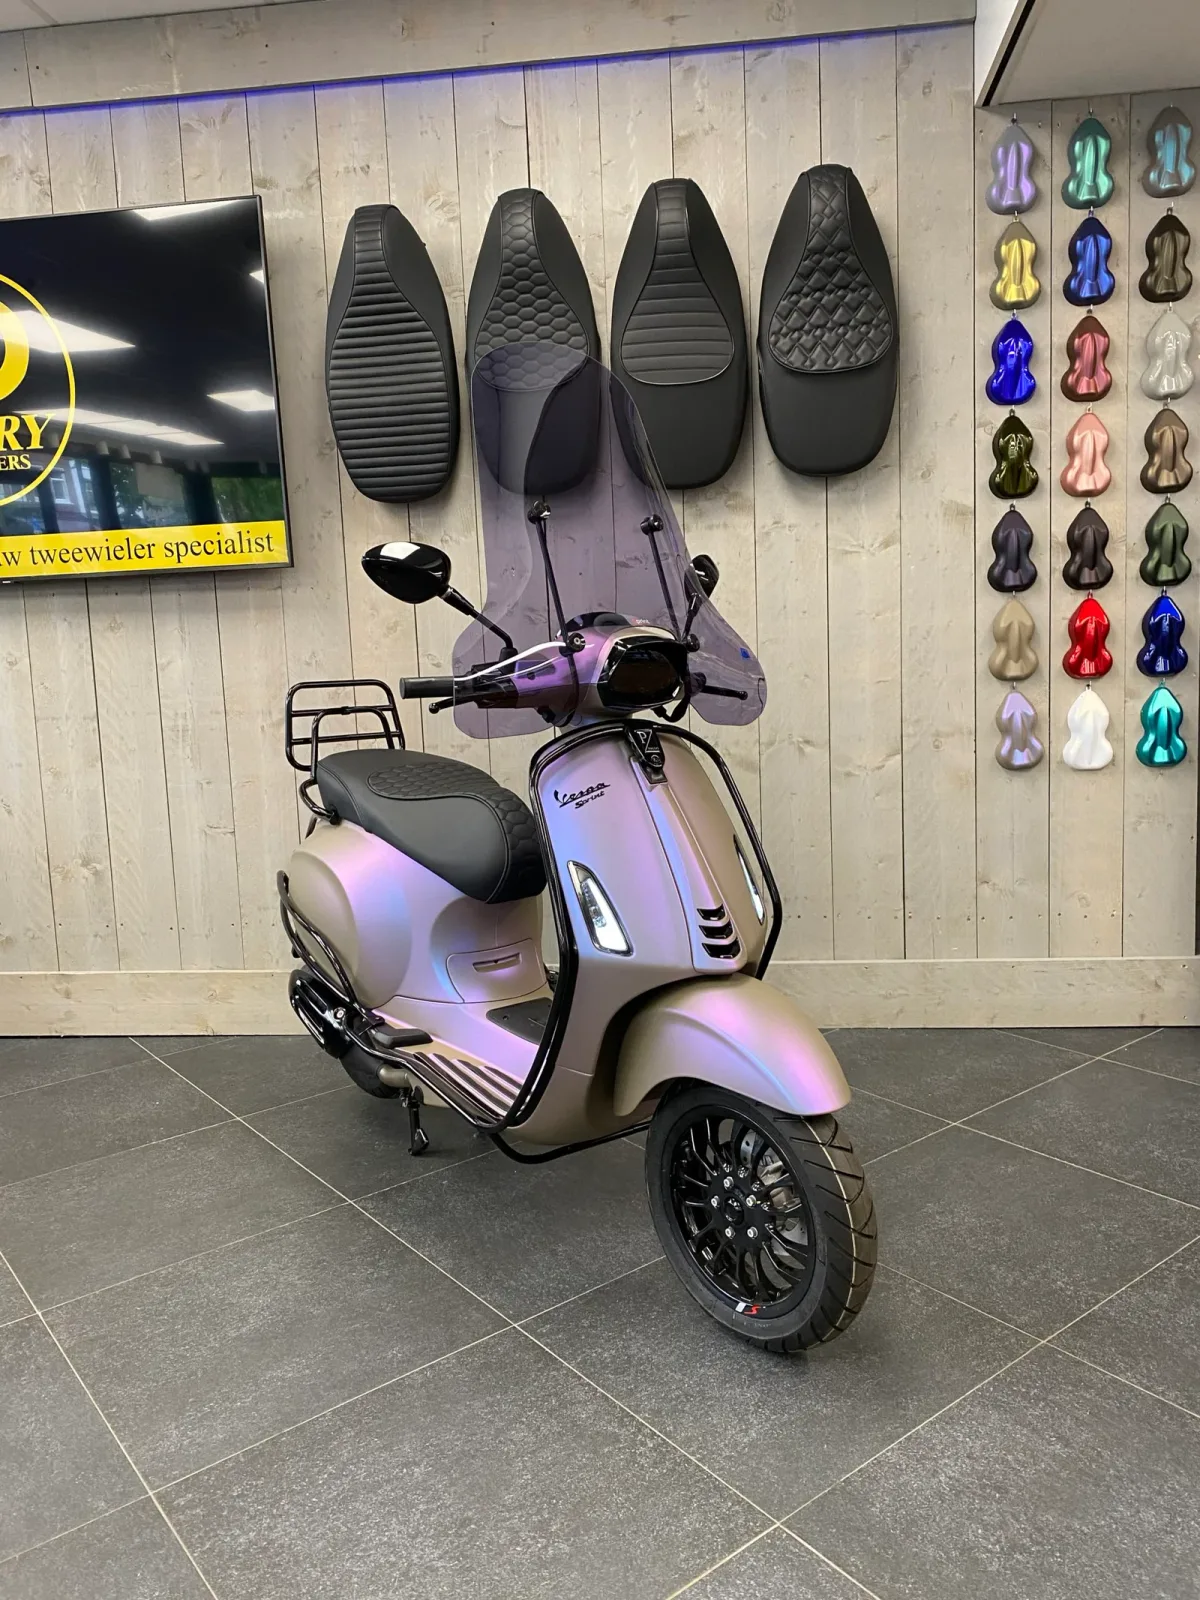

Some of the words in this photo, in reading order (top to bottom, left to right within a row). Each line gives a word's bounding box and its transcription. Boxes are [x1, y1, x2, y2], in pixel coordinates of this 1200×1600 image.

[30, 537, 156, 565] tweewieler
[164, 530, 274, 563] specialist
[553, 782, 611, 808] Vespa
[575, 790, 605, 809] Sprint
